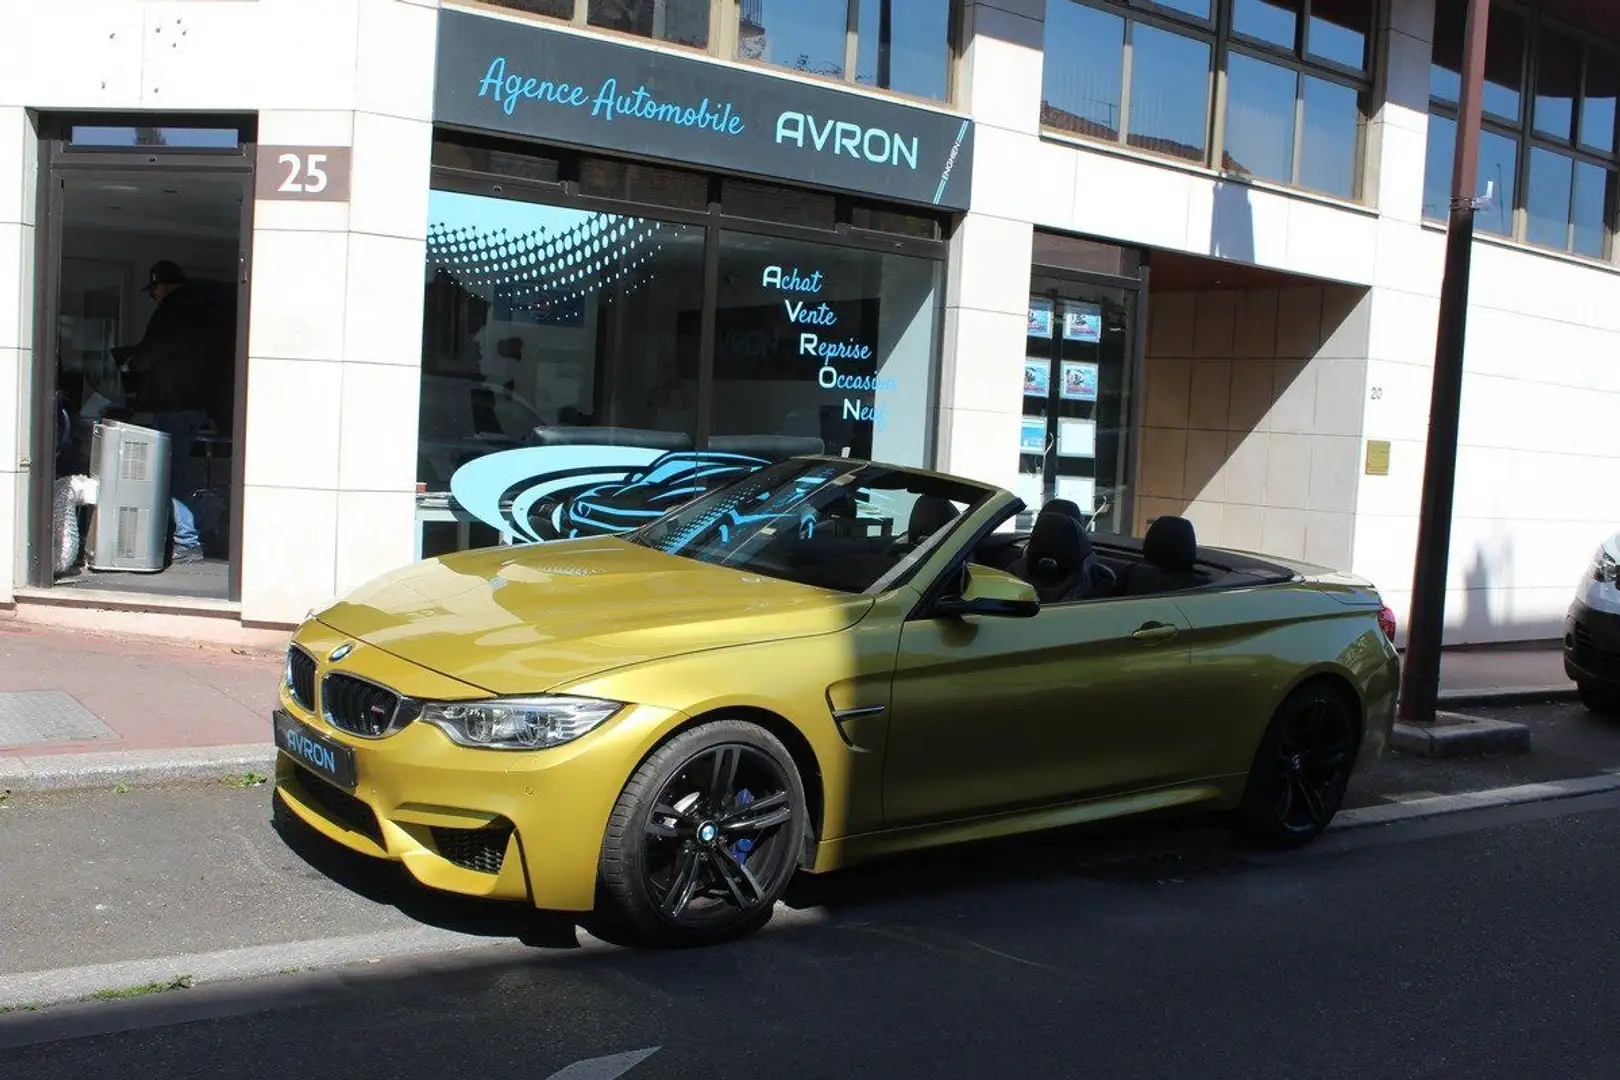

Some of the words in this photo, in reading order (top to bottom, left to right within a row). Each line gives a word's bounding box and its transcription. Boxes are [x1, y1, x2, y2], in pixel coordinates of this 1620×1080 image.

[478, 57, 589, 115] Agence
[591, 78, 745, 135] Automobile
[776, 111, 918, 170] AVRON
[277, 153, 328, 193] 25
[762, 265, 823, 293] Achat
[784, 299, 837, 326] Vente
[799, 333, 872, 365] Reprise
[1371, 387, 1382, 399] 20
[287, 729, 335, 773] AVRON
